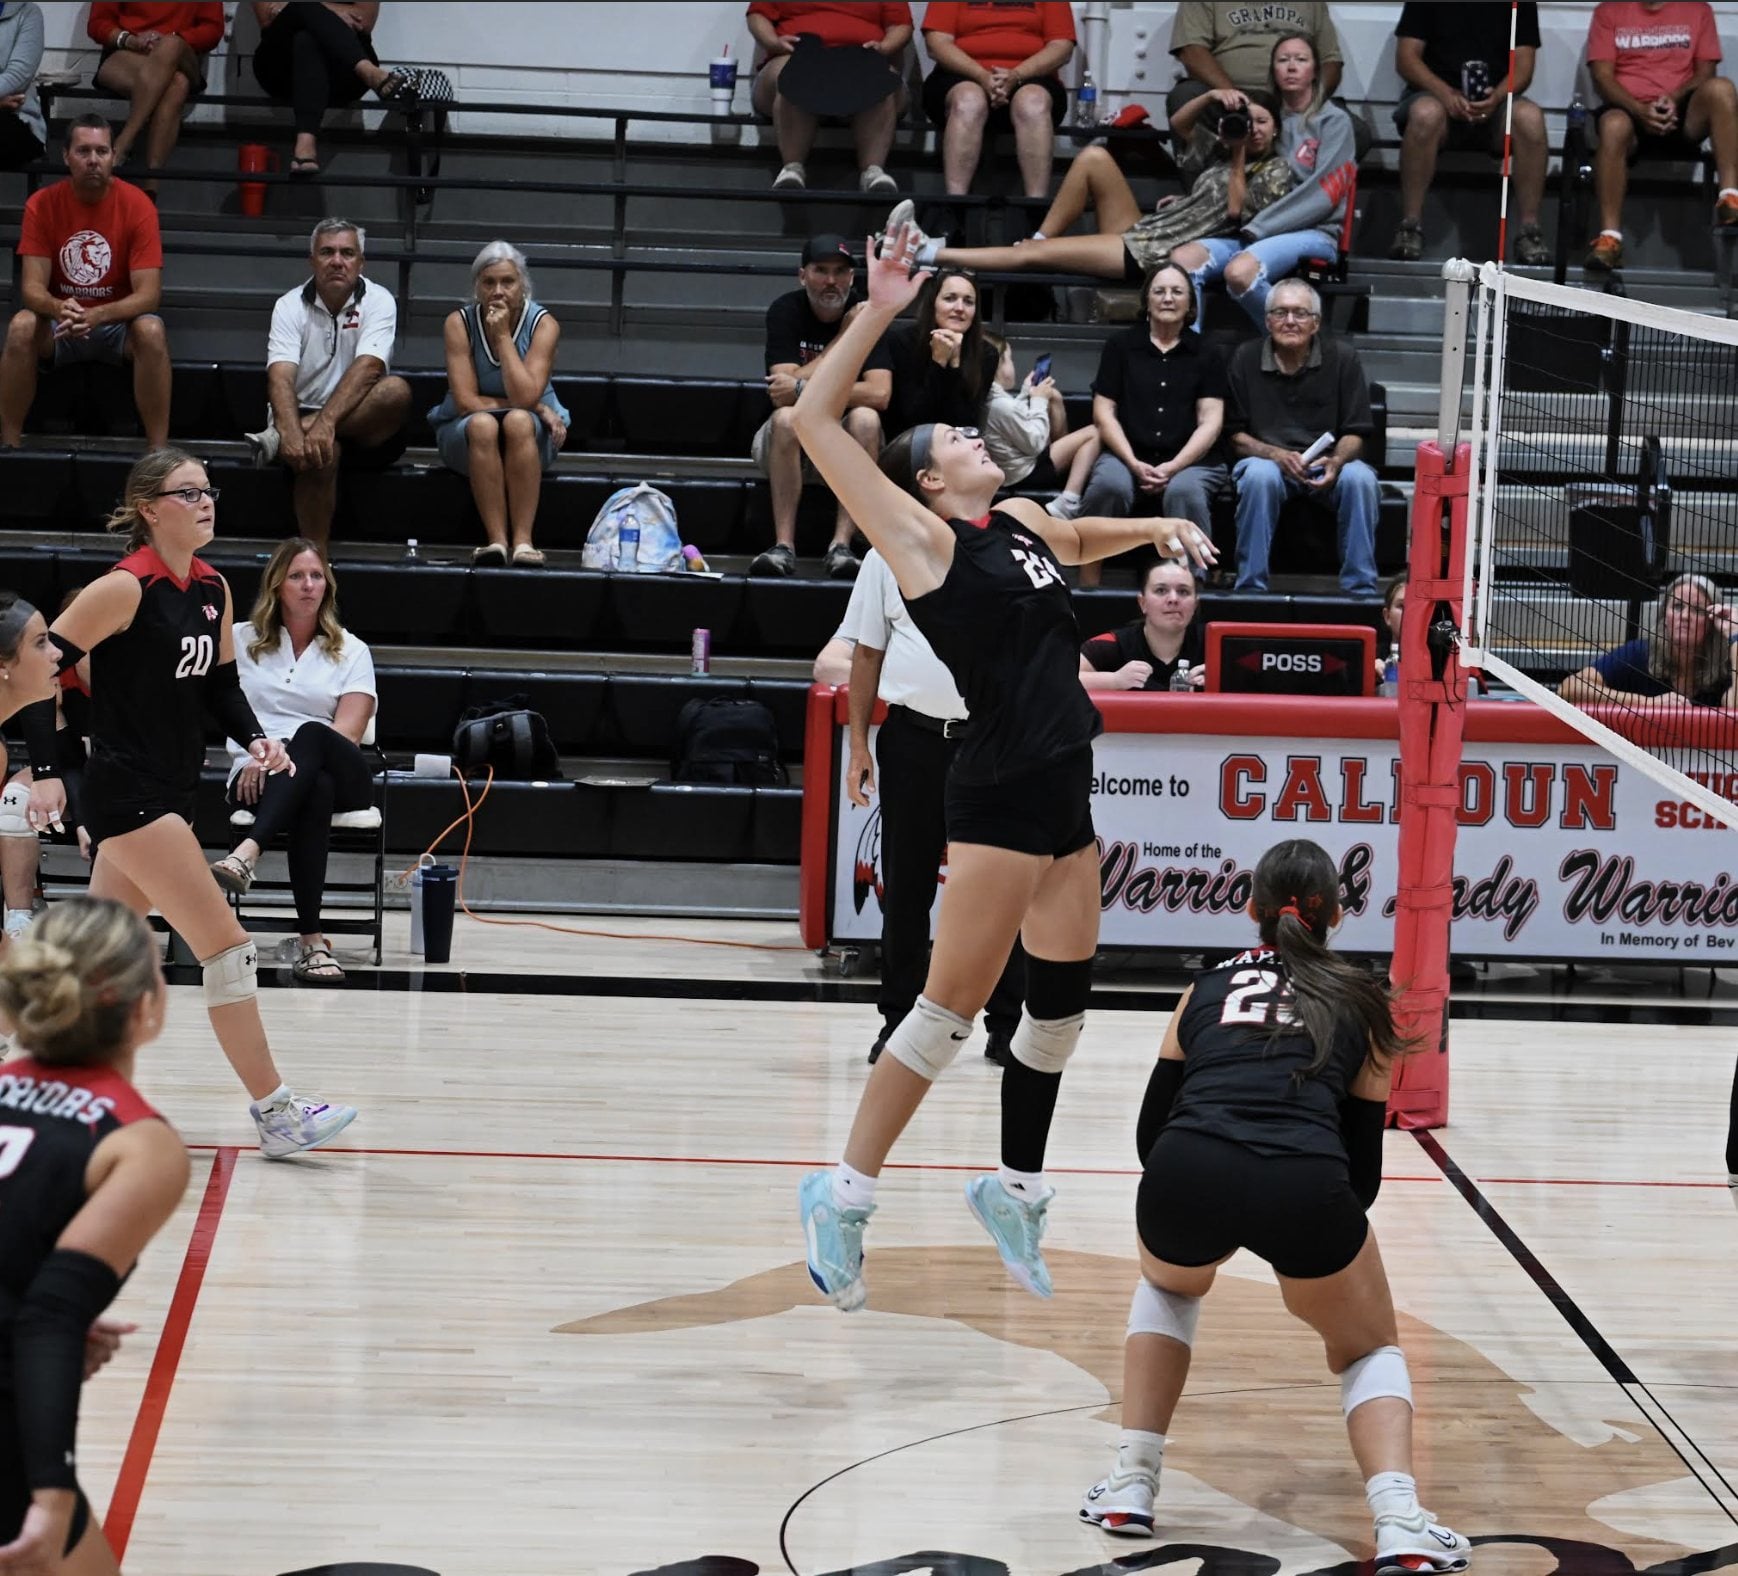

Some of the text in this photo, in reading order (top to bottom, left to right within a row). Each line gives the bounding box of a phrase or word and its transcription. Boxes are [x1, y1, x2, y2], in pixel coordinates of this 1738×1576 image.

[60, 283, 113, 298] WARRIORS
[175, 634, 214, 679] 20
[1262, 653, 1322, 673] POSS
[1090, 771, 1190, 797] elcome to
[1219, 753, 1618, 831] CALOUN
[1143, 841, 1222, 858] Home of the
[1095, 835, 1254, 914] arrio
[1382, 855, 1540, 941] ady
[1601, 931, 1735, 950] In Memory of Bev
